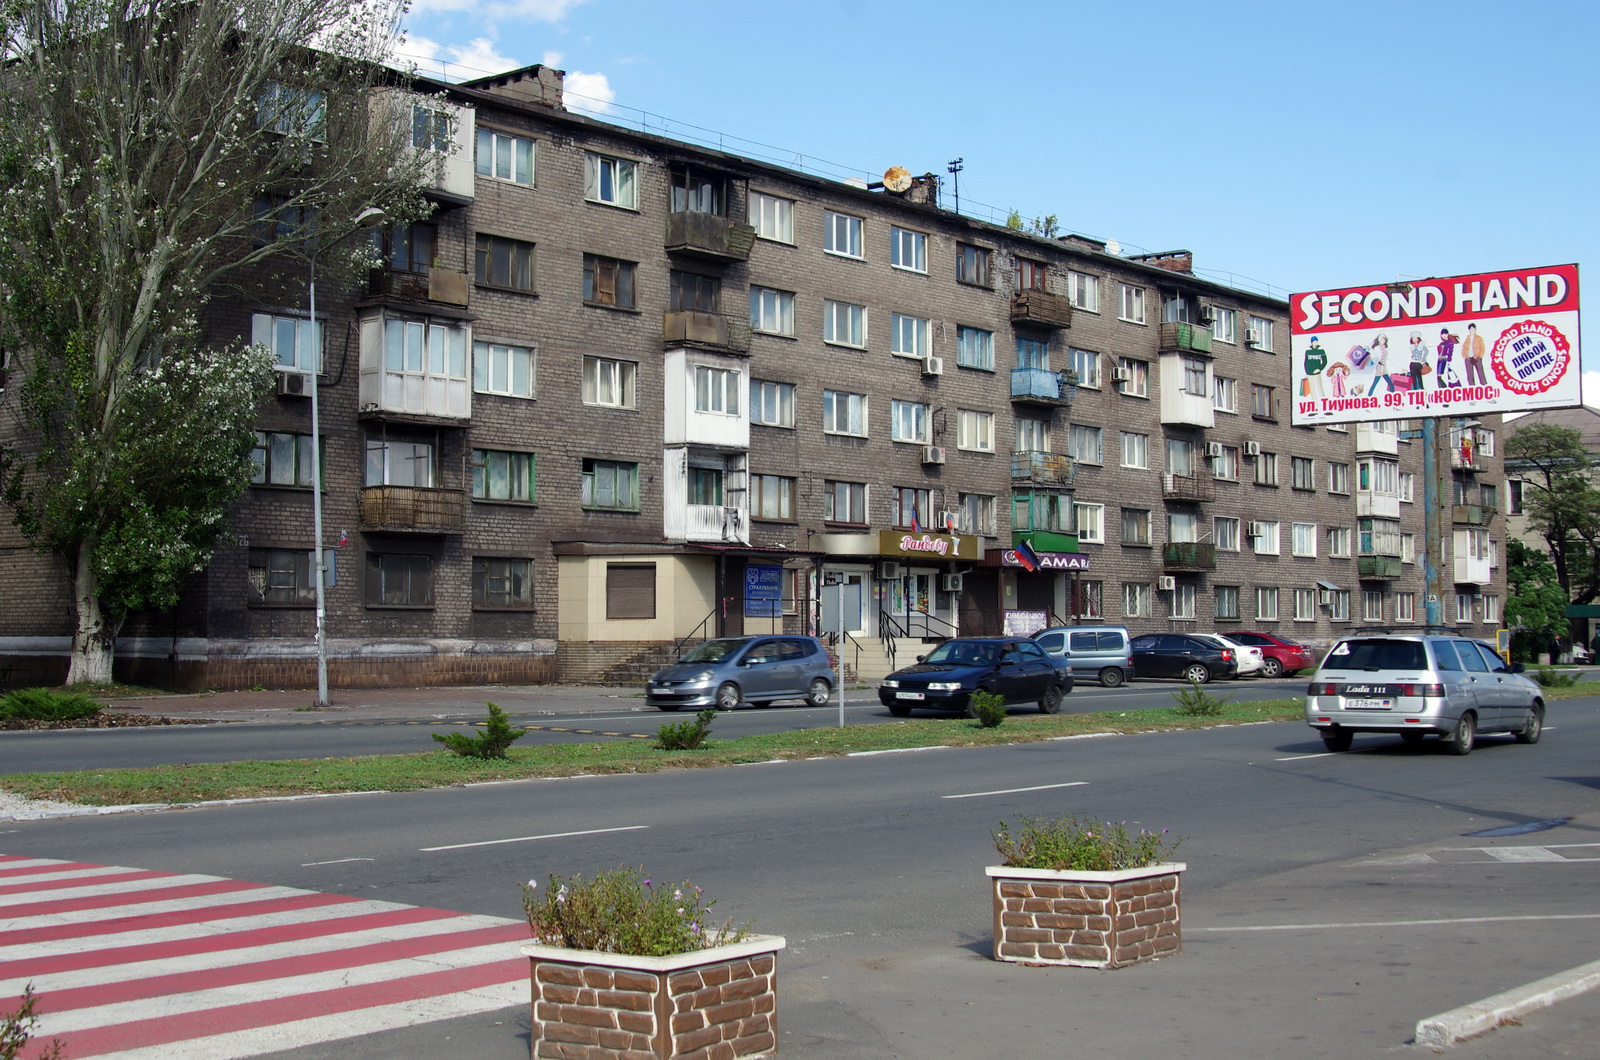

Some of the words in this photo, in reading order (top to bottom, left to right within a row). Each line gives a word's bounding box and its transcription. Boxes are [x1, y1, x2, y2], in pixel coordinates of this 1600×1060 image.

[1299, 286, 1444, 330] SECOND
[1453, 274, 1568, 314] HAND
[1494, 329, 1518, 363] SECOND
[1520, 324, 1552, 337] HAND
[1511, 341, 1547, 368] ЛЮБОЙ
[1512, 336, 1532, 352] ПРИ
[1517, 353, 1554, 379] ПОГОДЕ
[1542, 349, 1567, 386] SECOND
[1507, 380, 1539, 391] HAND
[1299, 401, 1318, 414] ул.
[1321, 397, 1381, 411] Тиунова,
[1384, 393, 1404, 407] 99,
[1407, 391, 1425, 406] ТЦ
[1428, 386, 1500, 403] «КОСМОС»
[239, 535, 249, 546] 26
[900, 535, 948, 556] Рандеву
[1346, 685, 1370, 693] Lada
